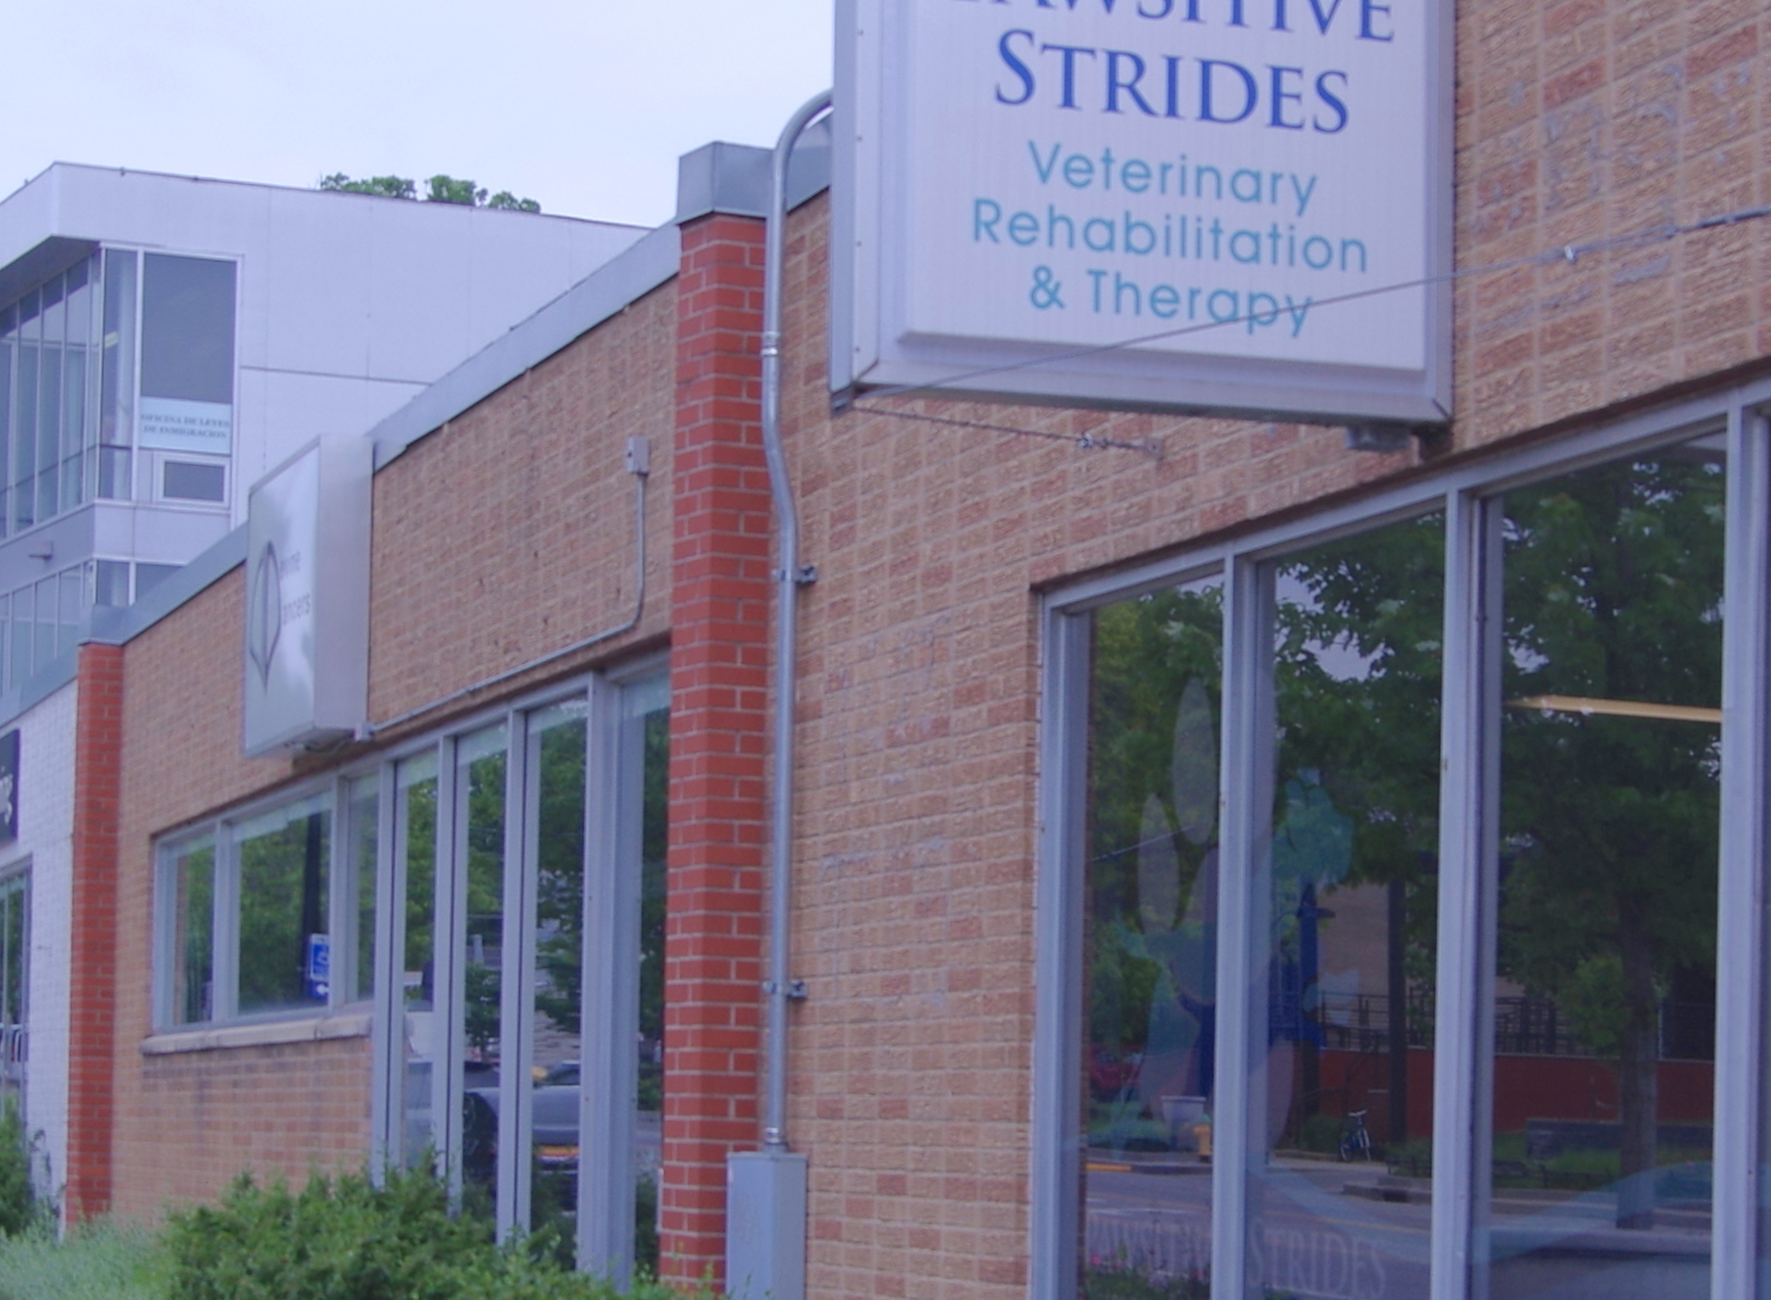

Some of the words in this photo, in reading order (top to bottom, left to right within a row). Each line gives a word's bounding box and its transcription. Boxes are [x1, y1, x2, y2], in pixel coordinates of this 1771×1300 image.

[995, 29, 1349, 134] STRIDES
[1030, 140, 1318, 218] Veterinary
[973, 199, 1368, 274] Rehabilitation
[1030, 266, 1066, 309] &
[1087, 269, 1314, 338] Therapy
